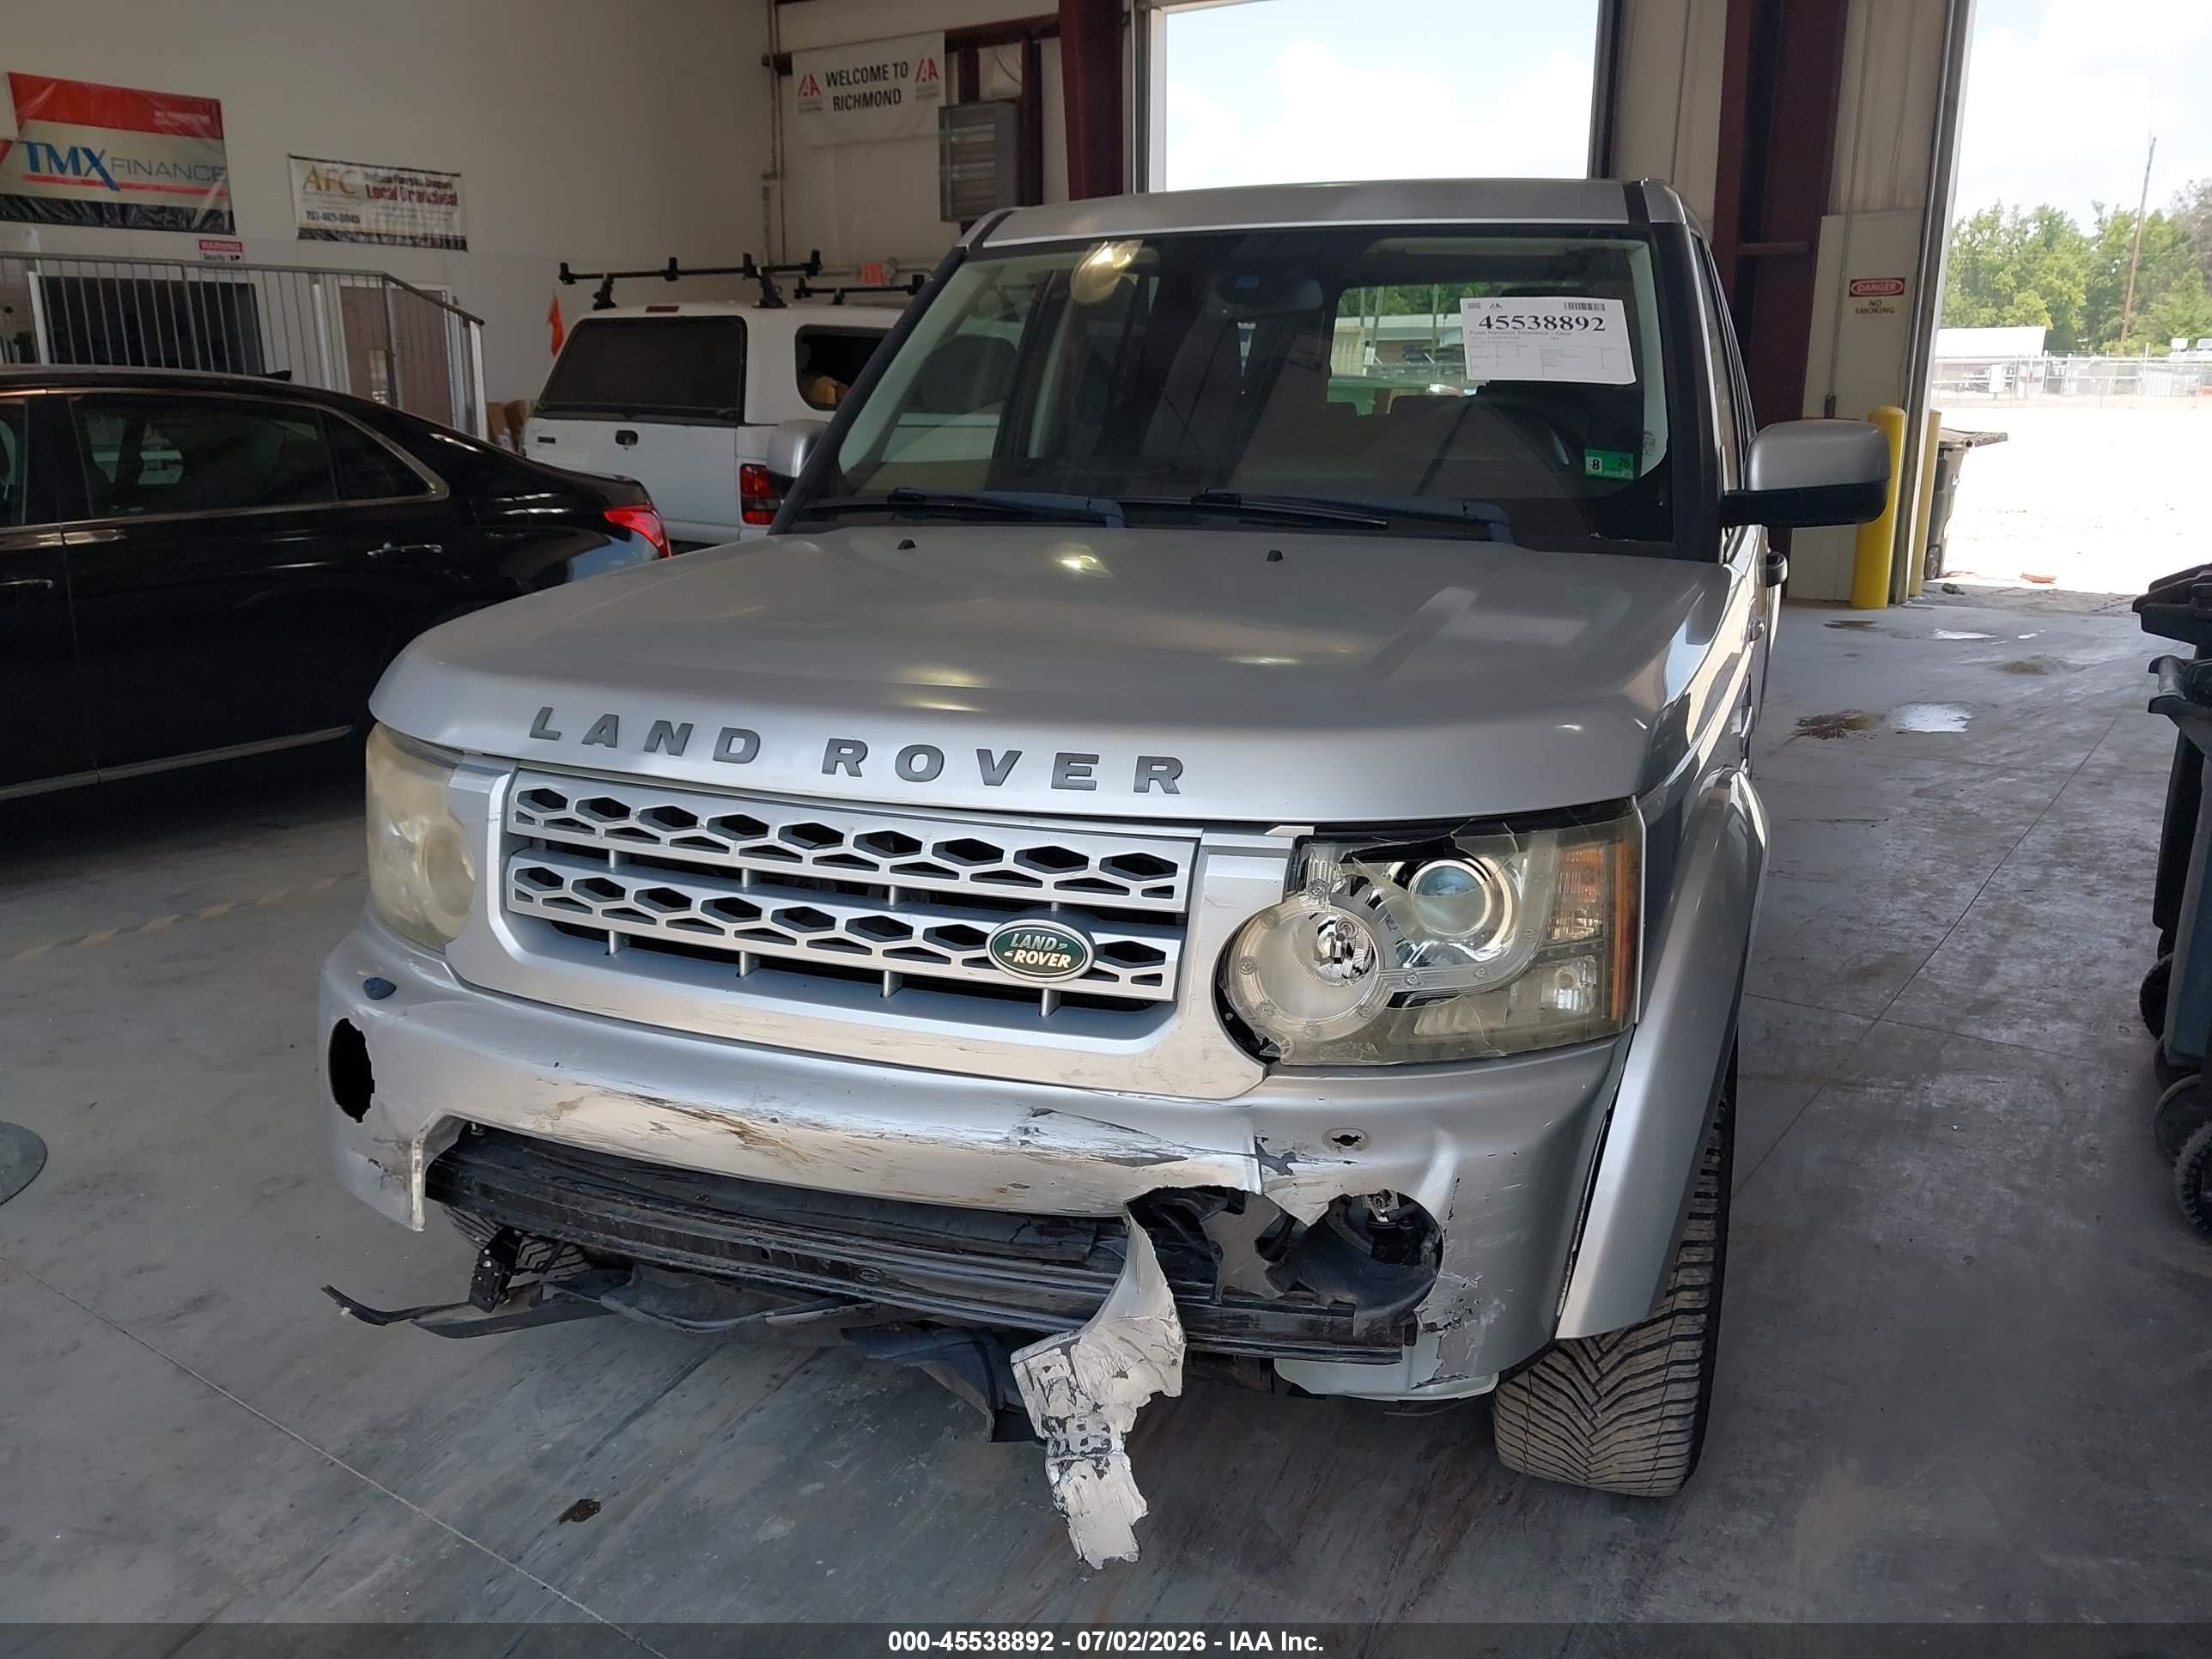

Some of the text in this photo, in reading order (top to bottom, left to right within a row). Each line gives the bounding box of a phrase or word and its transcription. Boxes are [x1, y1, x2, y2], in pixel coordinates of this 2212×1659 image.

[825, 62, 908, 88] WELCOME TO
[833, 88, 902, 112] RICHMOND
[17, 140, 228, 191] TMX FINANCE
[302, 166, 357, 194] AFC
[366, 184, 398, 201] Local
[1857, 283, 1896, 292] DANGER
[1479, 315, 1606, 331] 45538892
[1592, 459, 1600, 470] 8
[529, 706, 1184, 795] LAND ROVER
[1010, 933, 1057, 951] LAND
[1013, 949, 1072, 968] ROVER
